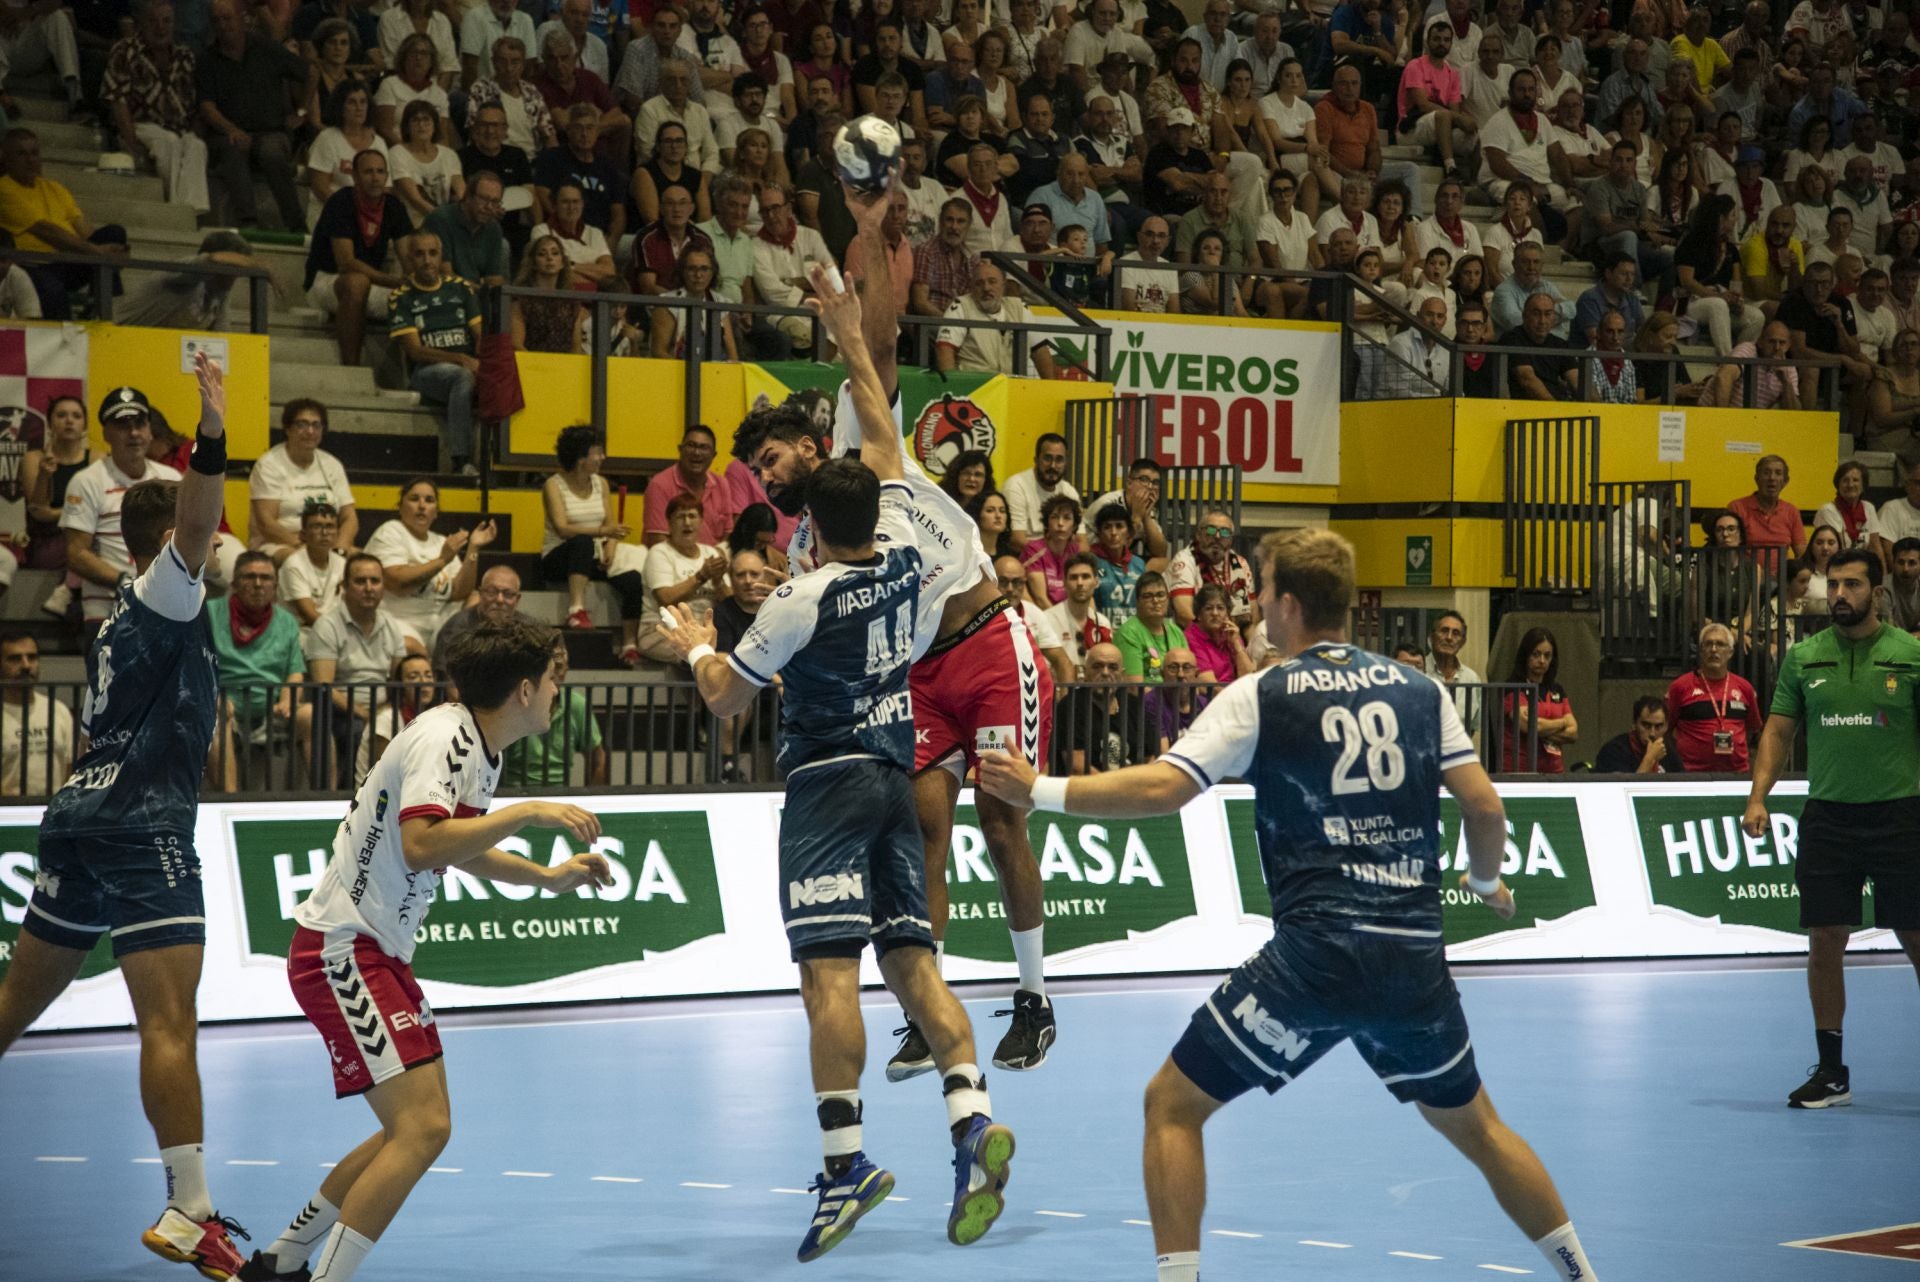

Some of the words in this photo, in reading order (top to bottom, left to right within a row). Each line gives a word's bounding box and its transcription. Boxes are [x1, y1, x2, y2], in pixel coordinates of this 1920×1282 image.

[846, 562, 919, 615] ABANC
[1110, 583, 1136, 605] 47
[963, 607, 995, 636] SELECT
[863, 599, 913, 684] 44
[1820, 713, 1873, 727] helvetia
[1321, 699, 1406, 797] 28
[1349, 815, 1395, 831] XUNTA
[1370, 827, 1424, 844] GALICIA
[358, 825, 384, 867] HIPER
[1661, 812, 1800, 878] HUER
[1726, 881, 1800, 900] SABOREA
[1043, 898, 1107, 919] UNTRY
[413, 921, 475, 944] OREA
[479, 920, 507, 941] EL
[512, 916, 620, 939] COUNTRY
[1556, 1245, 1584, 1281] Kempa
